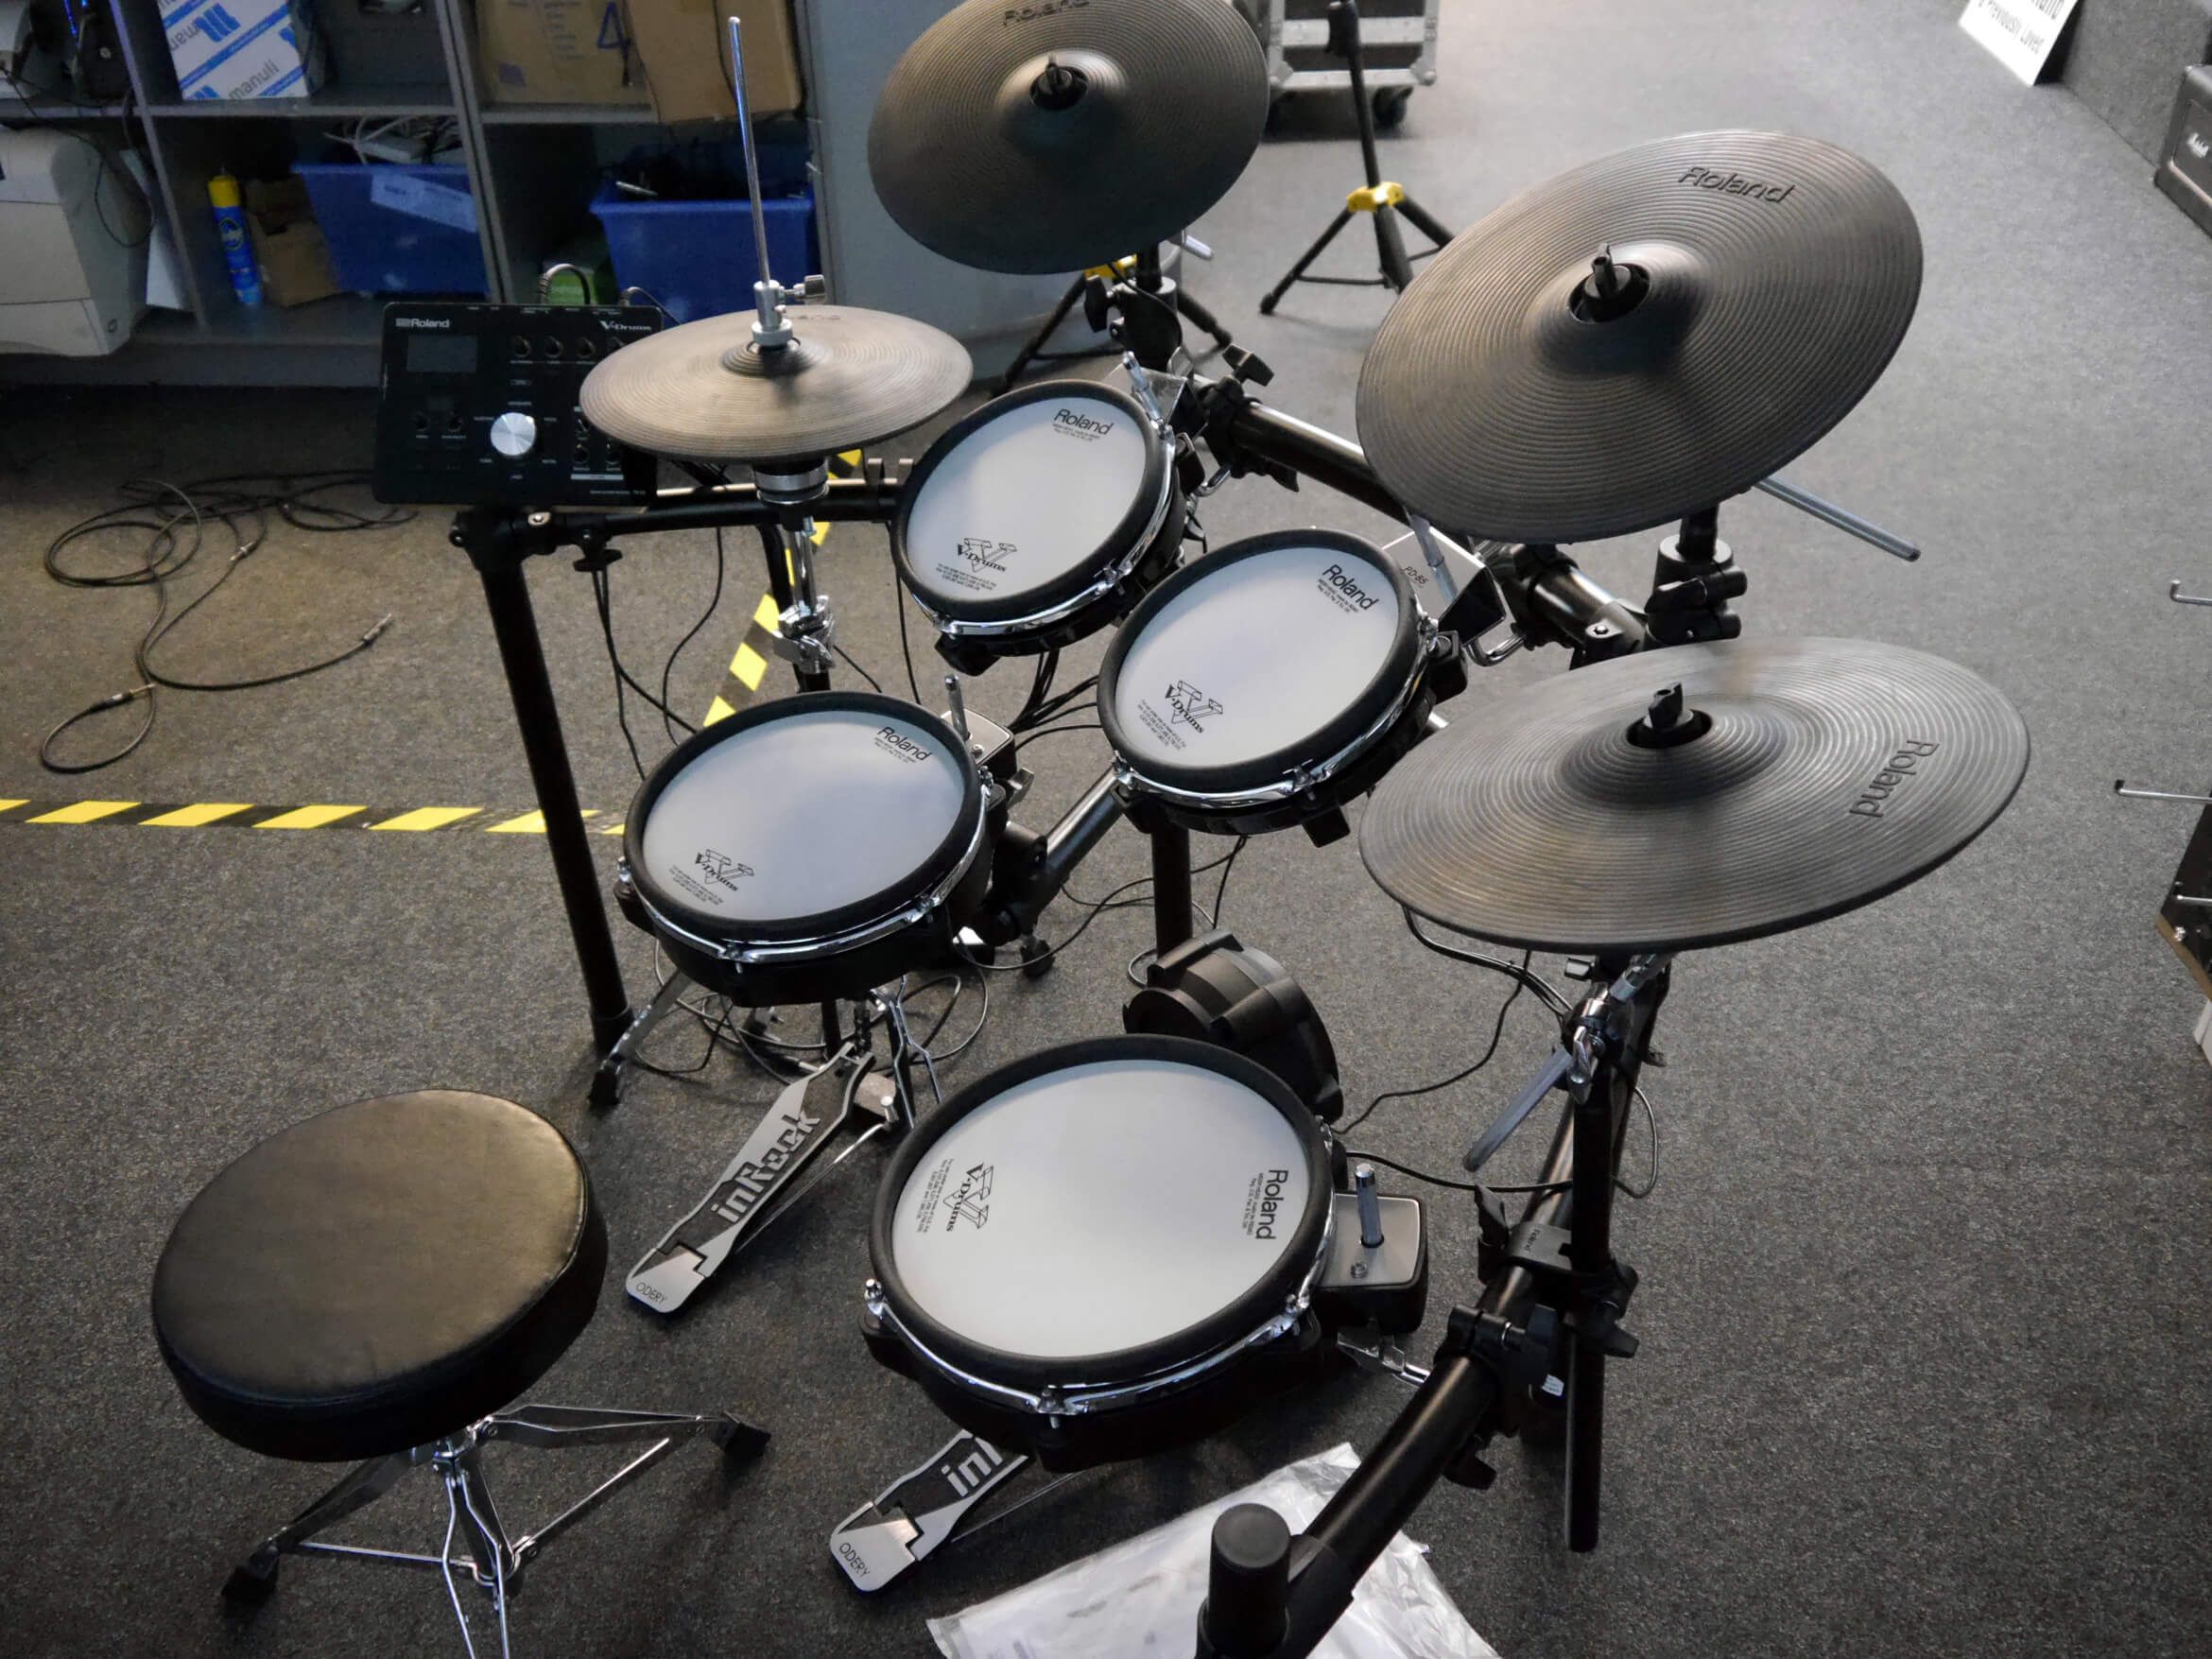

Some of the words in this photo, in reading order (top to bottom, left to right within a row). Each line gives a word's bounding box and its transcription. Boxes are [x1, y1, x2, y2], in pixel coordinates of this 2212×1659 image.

[1678, 166, 1796, 203] Roland
[410, 318, 450, 328] Roland
[1053, 407, 1115, 436] Roland
[1321, 563, 1380, 612] Roland
[876, 725, 933, 762] Roland
[1848, 739, 1941, 819] Roland
[1254, 1168, 1289, 1240] Roland
[635, 1281, 668, 1305] ODERY
[838, 1542, 872, 1579] ODERY
